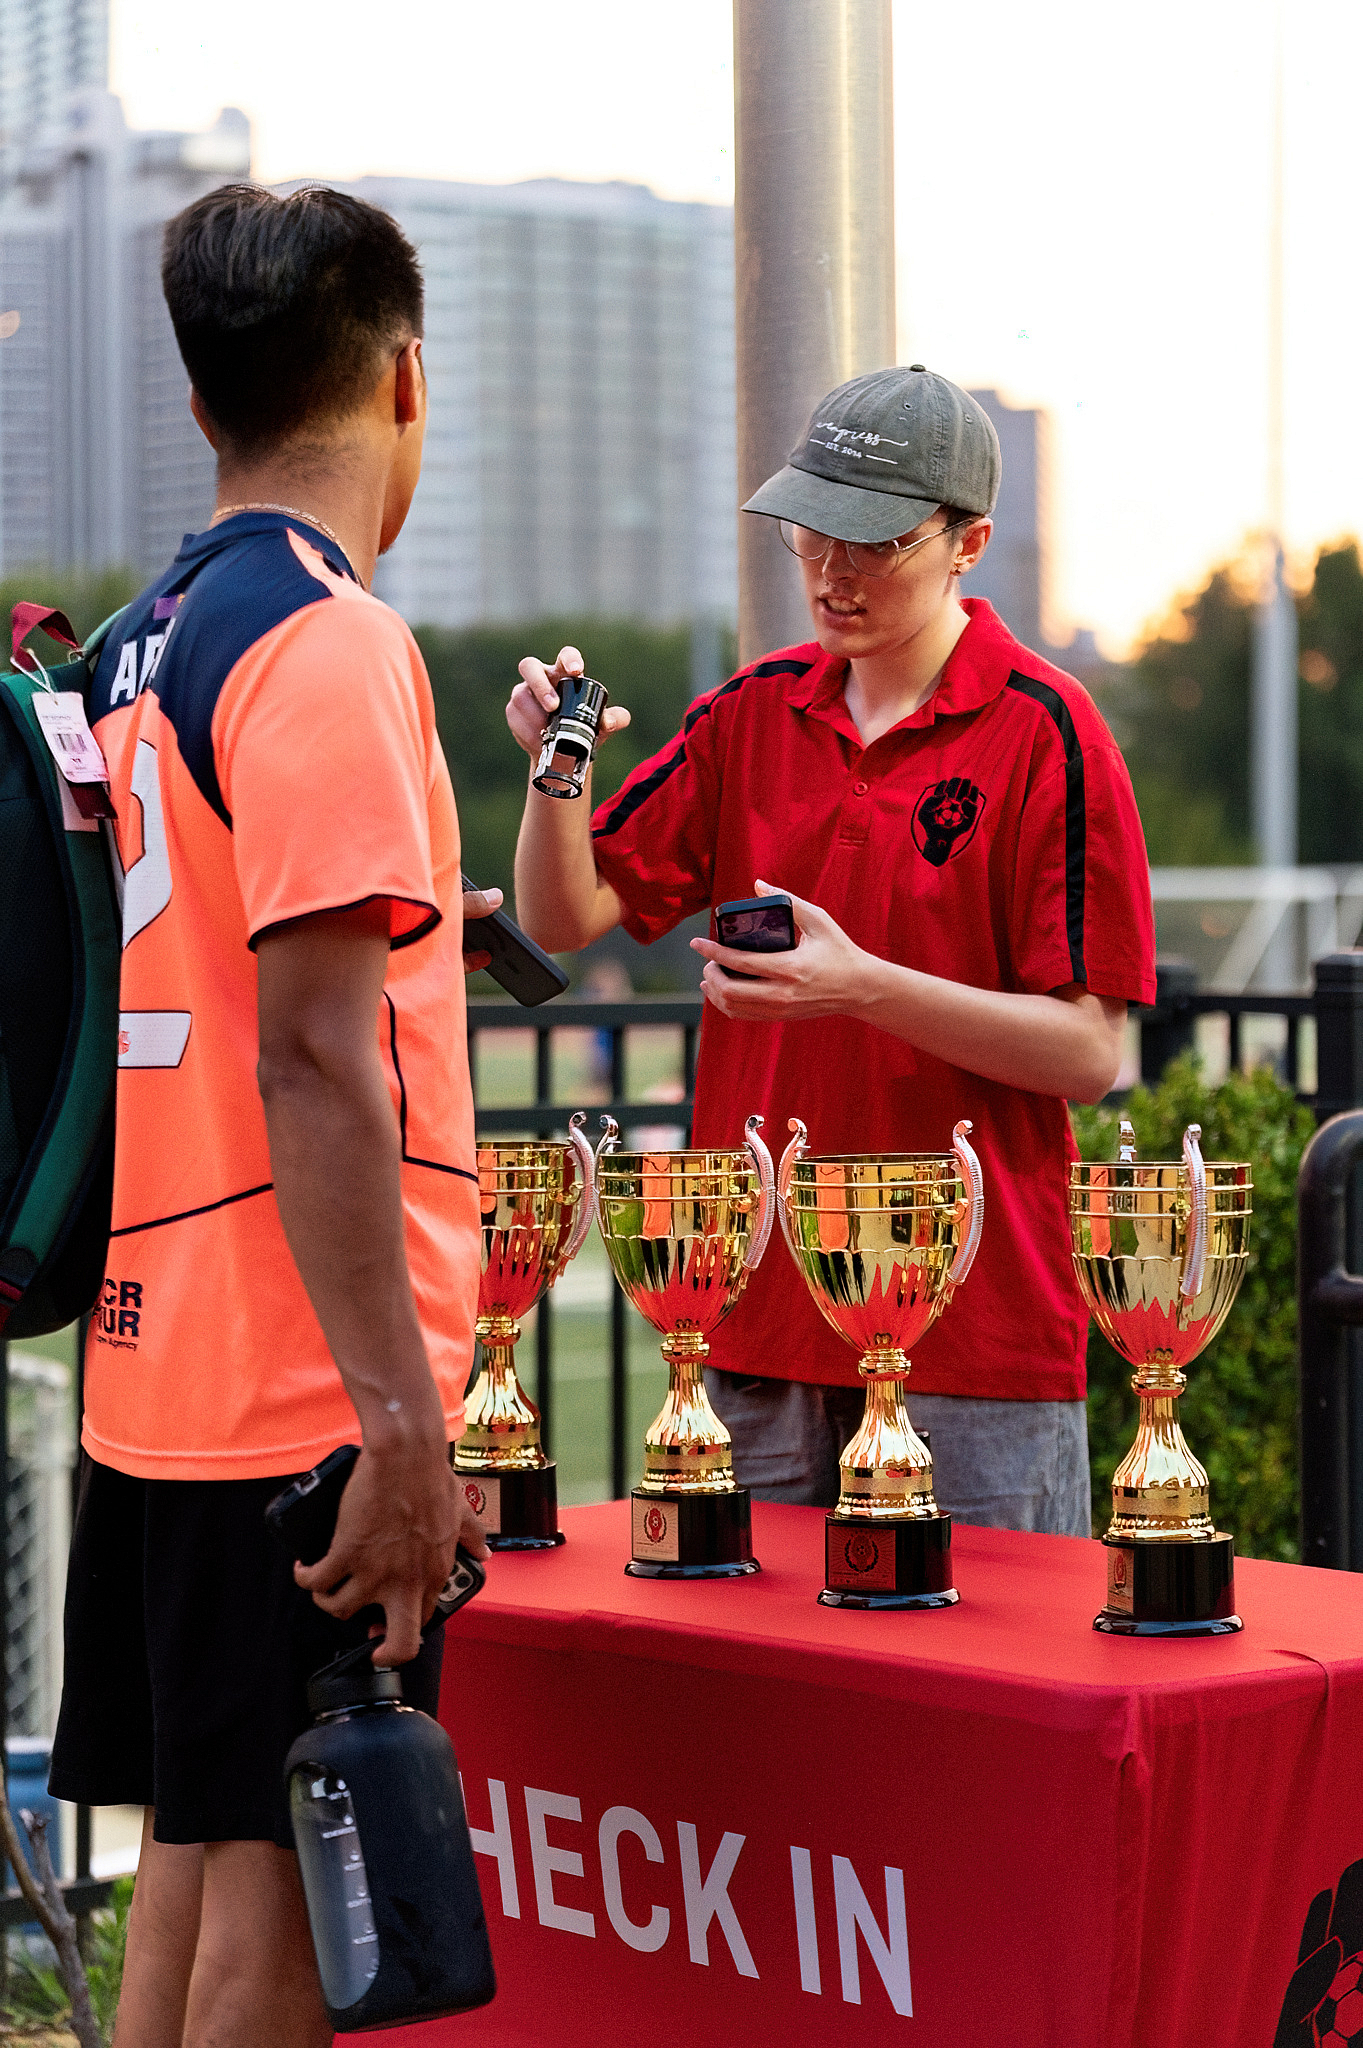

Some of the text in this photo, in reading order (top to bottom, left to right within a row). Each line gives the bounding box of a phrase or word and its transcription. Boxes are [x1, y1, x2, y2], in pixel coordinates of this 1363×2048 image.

[841, 446, 863, 459] 2014
[103, 1278, 143, 1309] CR
[458, 1771, 760, 1979] HECK
[790, 1845, 914, 2018] IN
